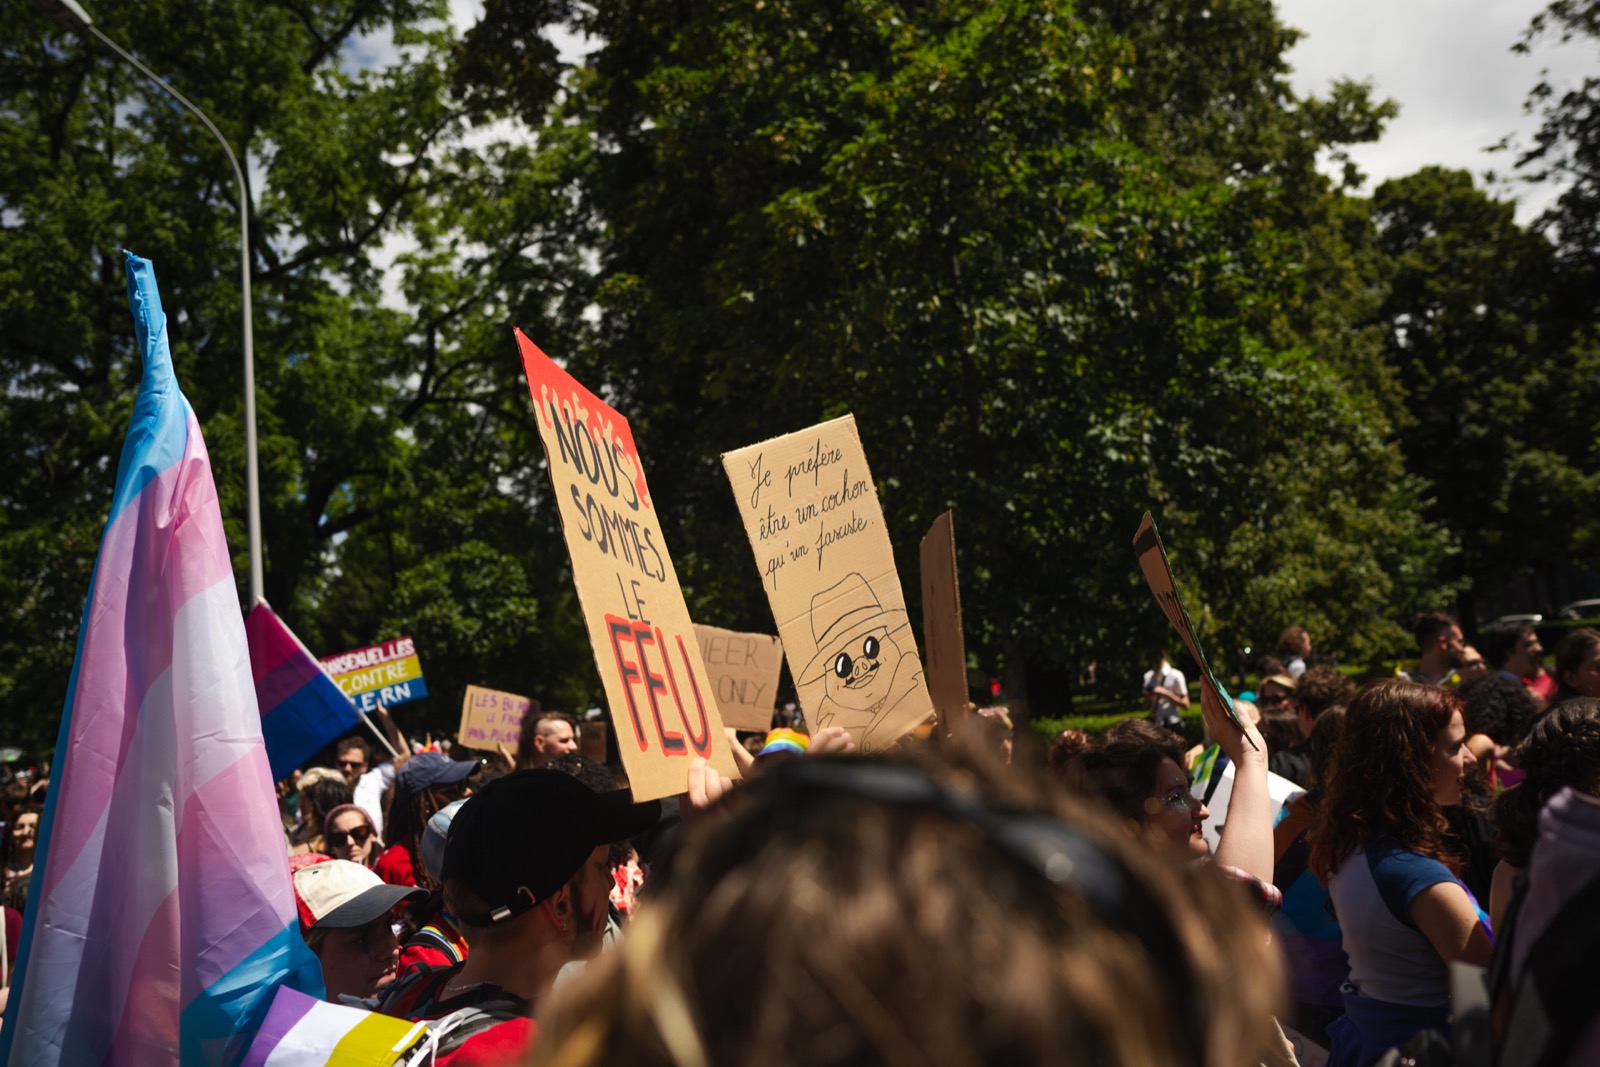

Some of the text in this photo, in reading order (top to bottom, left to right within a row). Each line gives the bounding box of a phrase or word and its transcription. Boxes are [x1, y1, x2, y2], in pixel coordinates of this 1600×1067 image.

[550, 402, 639, 511] NOUS
[747, 438, 843, 509] Je préfère
[759, 468, 869, 541] être un cochon
[570, 483, 666, 583] SOMMES
[765, 541, 809, 591] qu'un
[616, 572, 651, 625] LE
[340, 661, 409, 694] CONTRE
[703, 636, 759, 669] EER
[380, 682, 411, 706] RN
[604, 613, 712, 760] FEU
[717, 674, 767, 707] ONLY
